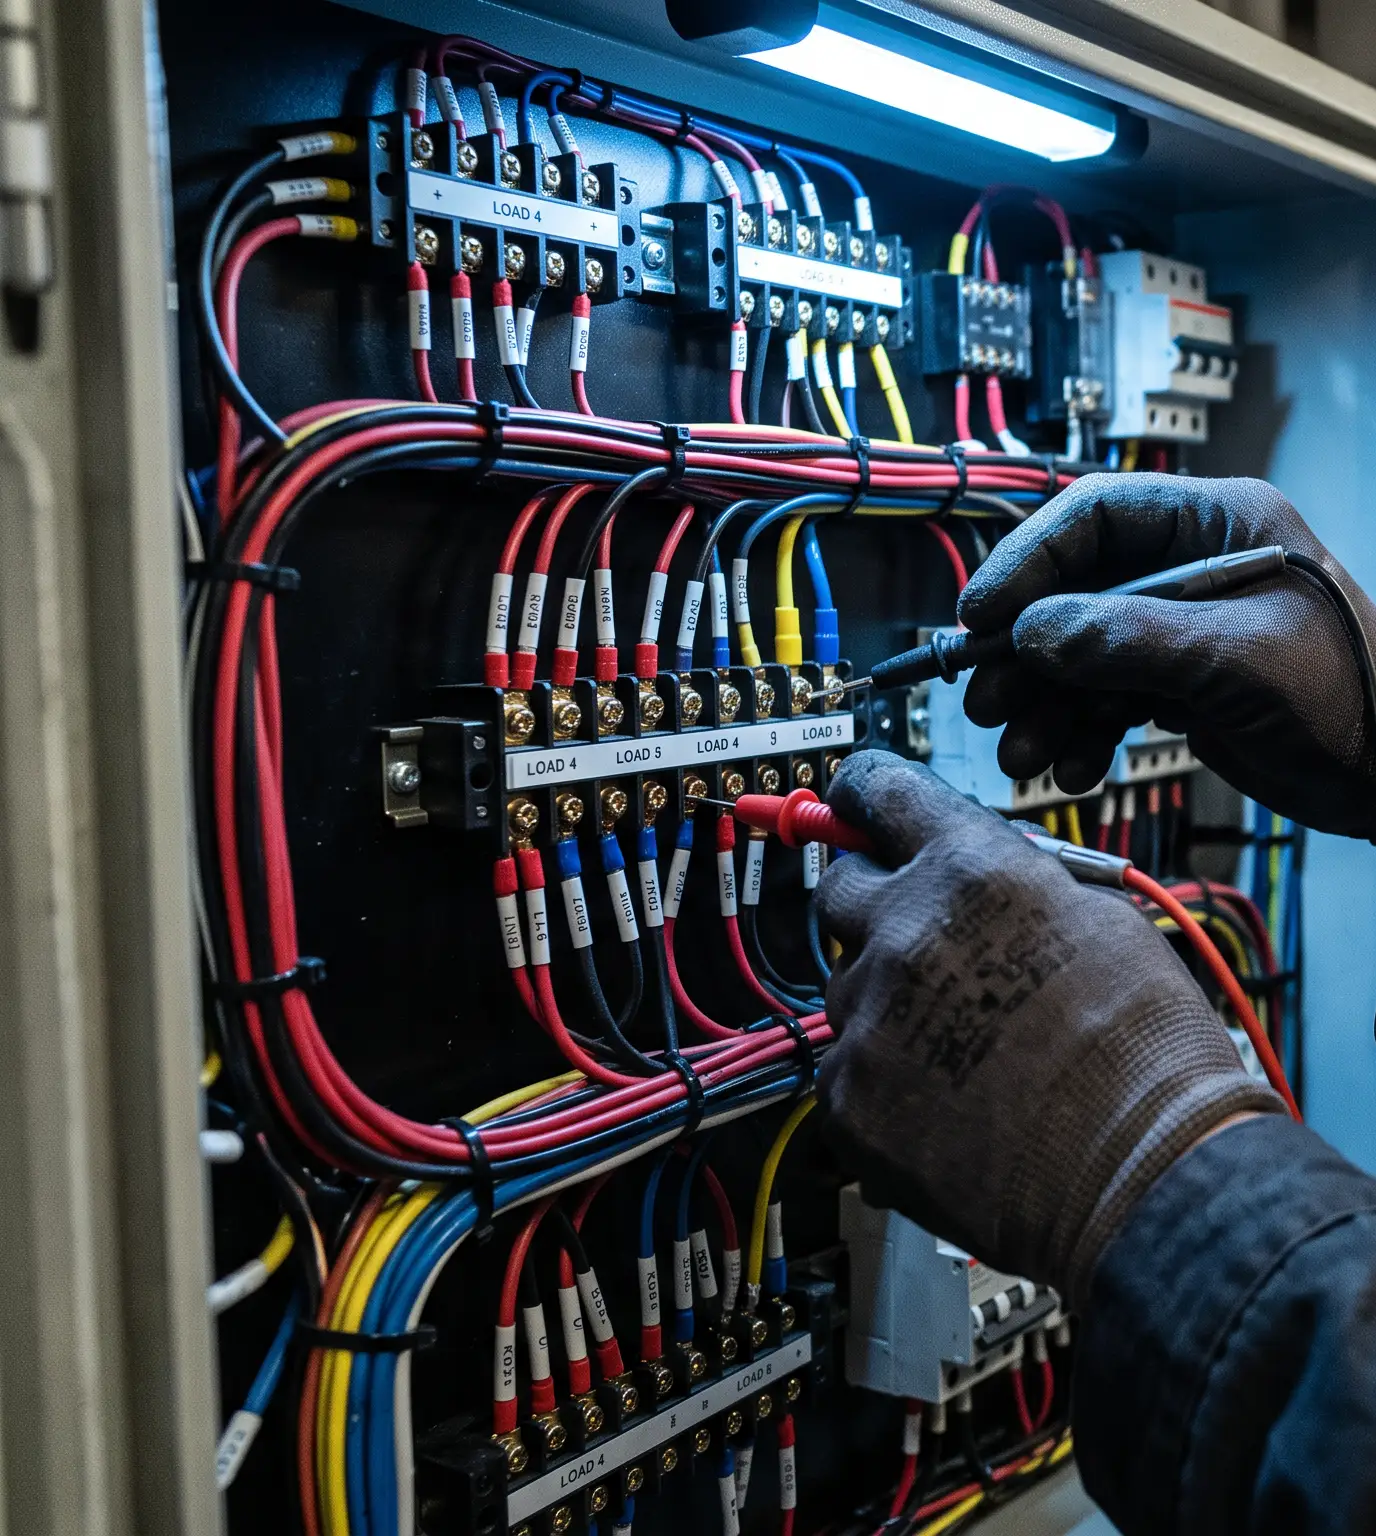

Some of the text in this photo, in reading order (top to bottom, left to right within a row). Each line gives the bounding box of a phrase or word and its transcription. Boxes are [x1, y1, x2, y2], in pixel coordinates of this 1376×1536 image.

[493, 201, 542, 223] LOAD 4
[527, 758, 565, 776] LOAD
[569, 757, 577, 770] 4
[616, 747, 651, 764] LOAD
[697, 738, 729, 754] LOAD
[732, 737, 739, 749] 4
[770, 731, 777, 746] 9
[802, 726, 833, 741] LOAD
[560, 1460, 595, 1488] LOAD
[597, 1453, 605, 1466] 4
[737, 1368, 764, 1392] LOAD
